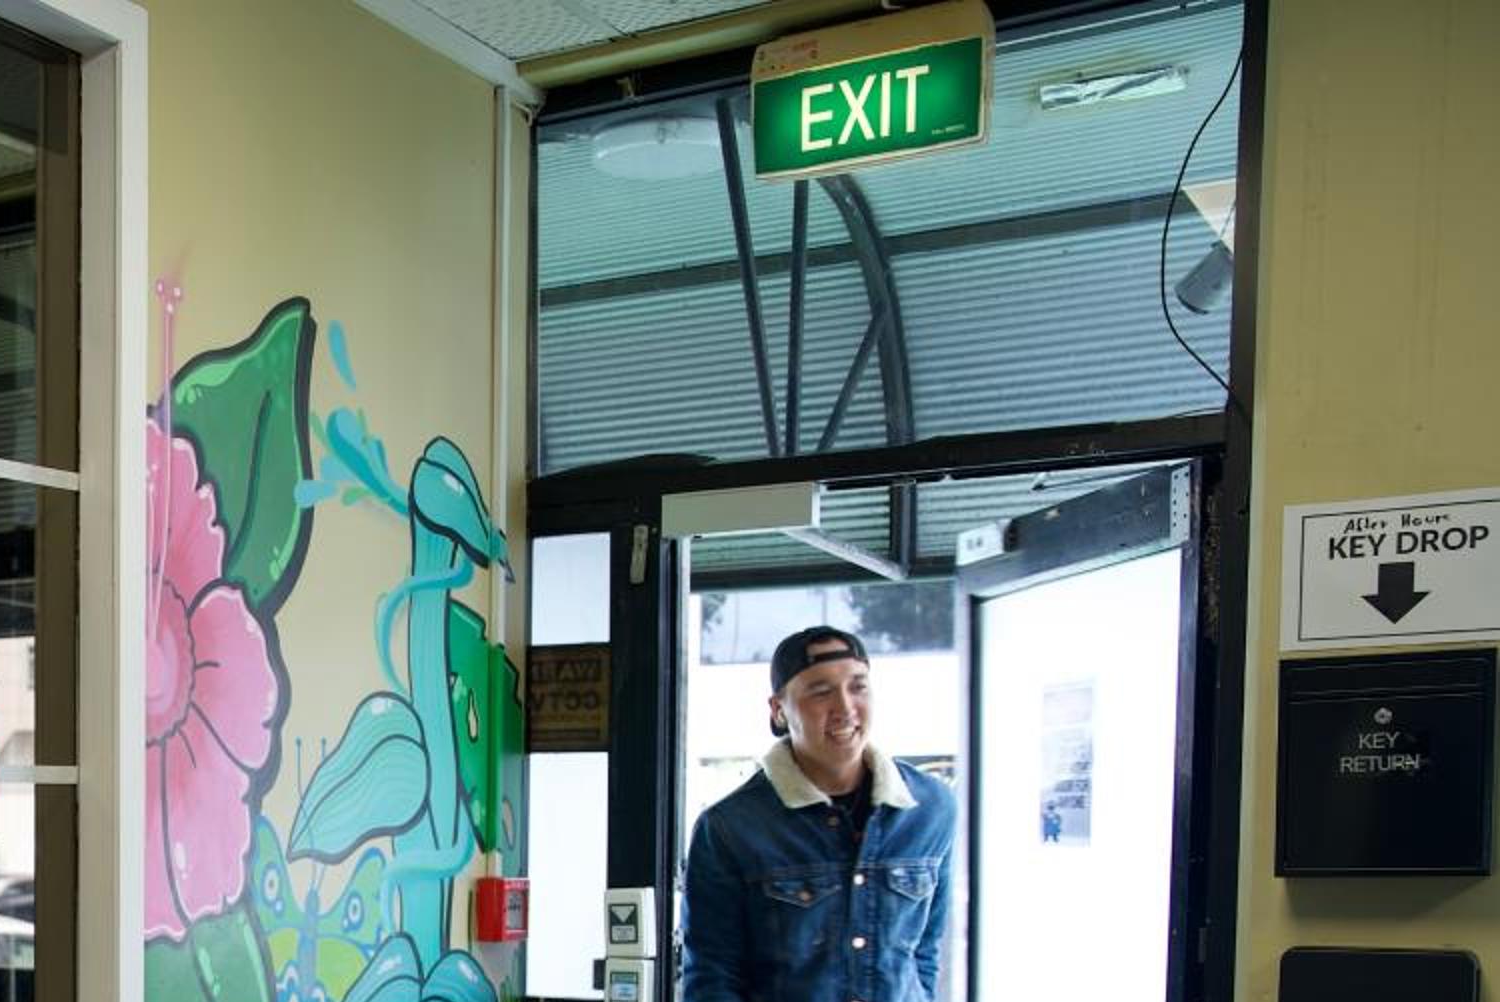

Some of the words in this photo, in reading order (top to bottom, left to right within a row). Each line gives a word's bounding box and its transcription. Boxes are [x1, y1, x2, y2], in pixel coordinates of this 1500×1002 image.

[801, 64, 929, 153] EXIT
[1328, 533, 1387, 560] KEY
[1395, 525, 1489, 555] DROP
[1358, 731, 1401, 750] KEY
[1339, 753, 1421, 773] RETURN
